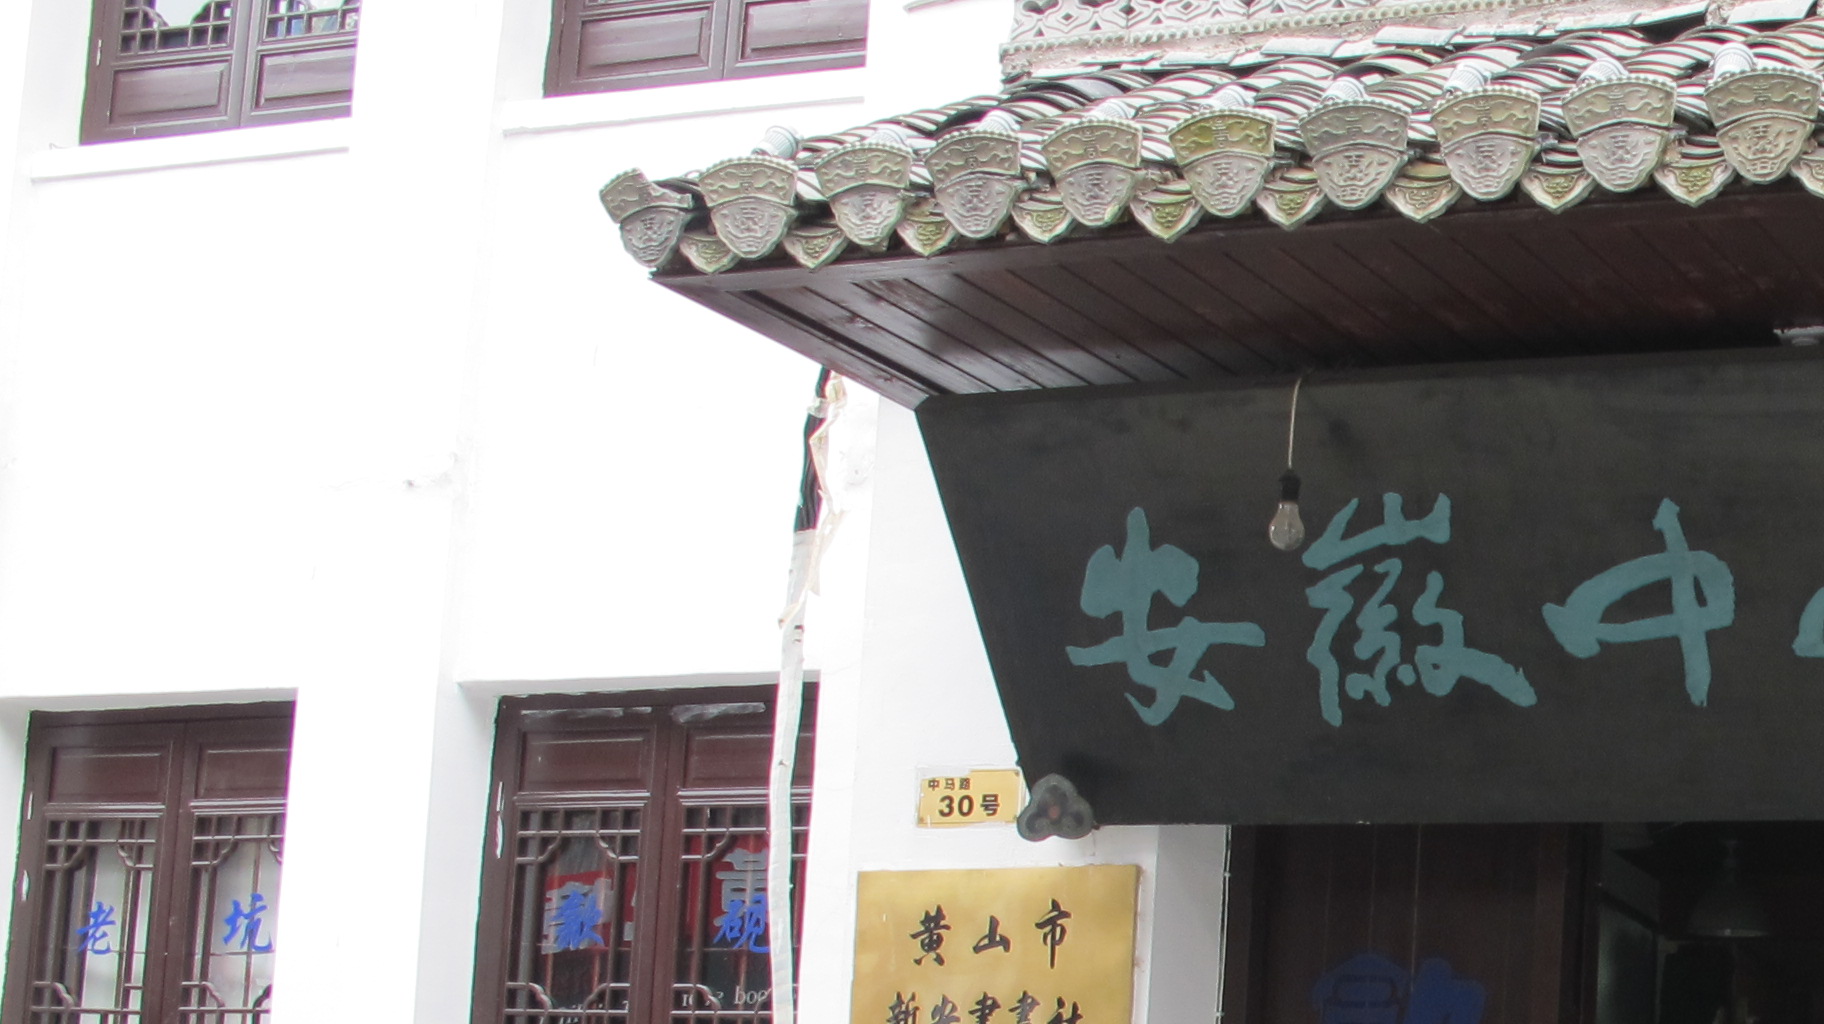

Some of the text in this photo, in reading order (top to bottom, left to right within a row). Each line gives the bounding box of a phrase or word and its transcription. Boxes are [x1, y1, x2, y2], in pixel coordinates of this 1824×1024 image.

[927, 777, 971, 791] 中马路
[938, 793, 1000, 818] 30号
[75, 892, 273, 955] 老坑
[909, 898, 1072, 969] 黄山市
